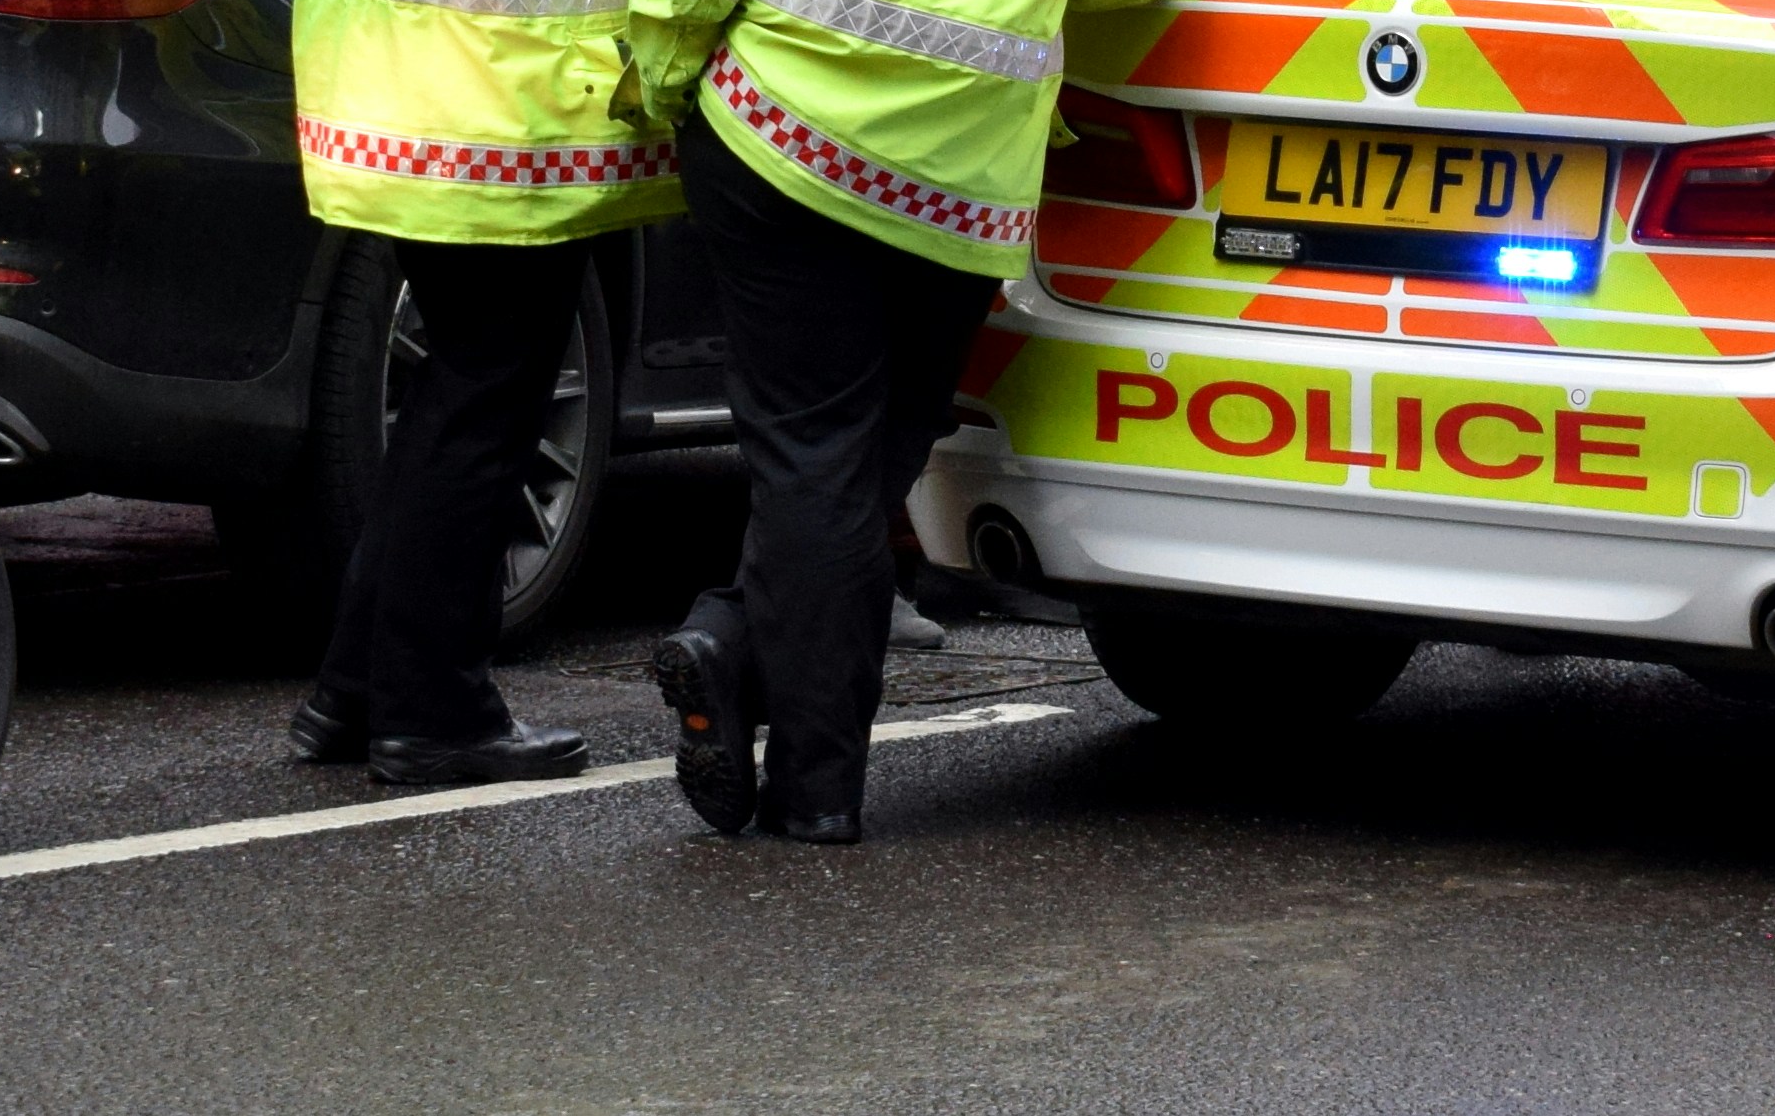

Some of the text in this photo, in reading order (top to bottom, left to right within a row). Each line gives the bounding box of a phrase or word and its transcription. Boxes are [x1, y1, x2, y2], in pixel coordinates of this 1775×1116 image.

[1264, 134, 1564, 221] LA17 FDY
[1095, 369, 1648, 491] POLICE
